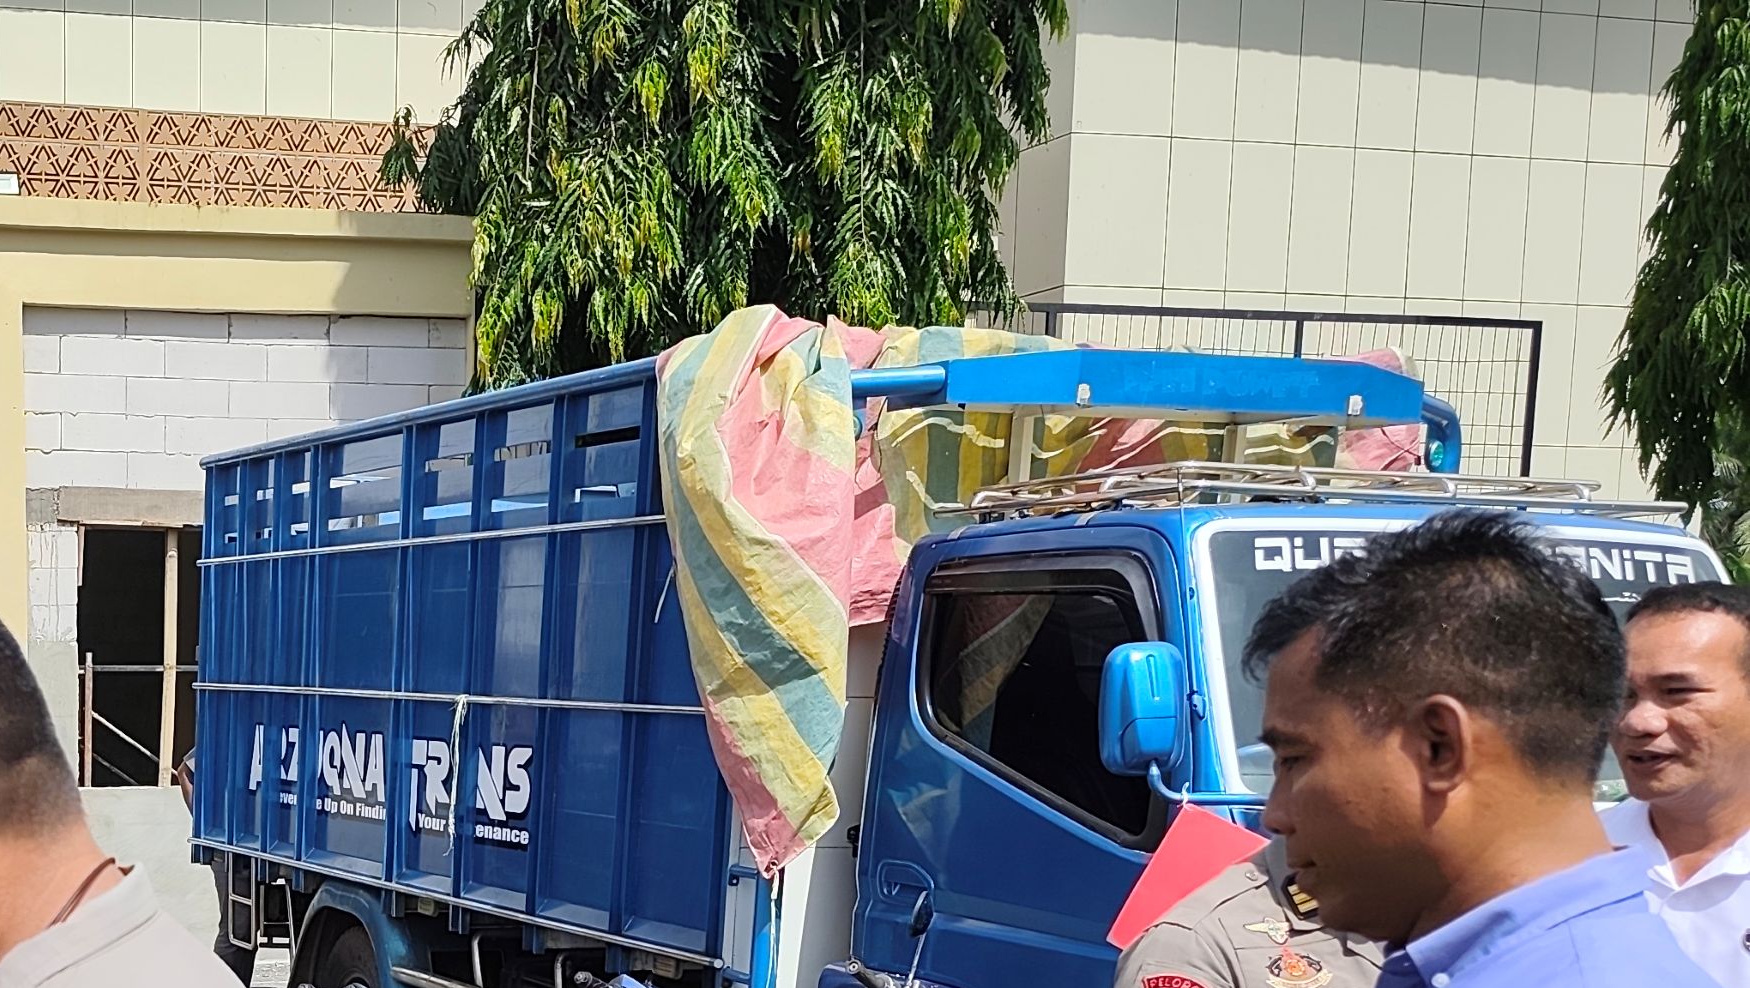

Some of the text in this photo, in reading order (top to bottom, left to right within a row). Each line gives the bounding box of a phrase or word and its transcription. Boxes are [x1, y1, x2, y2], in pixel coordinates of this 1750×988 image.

[1544, 545, 1696, 586] ANITA
[409, 739, 533, 831] TRNS
[324, 797, 338, 814] Up
[339, 800, 354, 815] On
[418, 813, 447, 832] Your
[473, 824, 530, 845] enance
